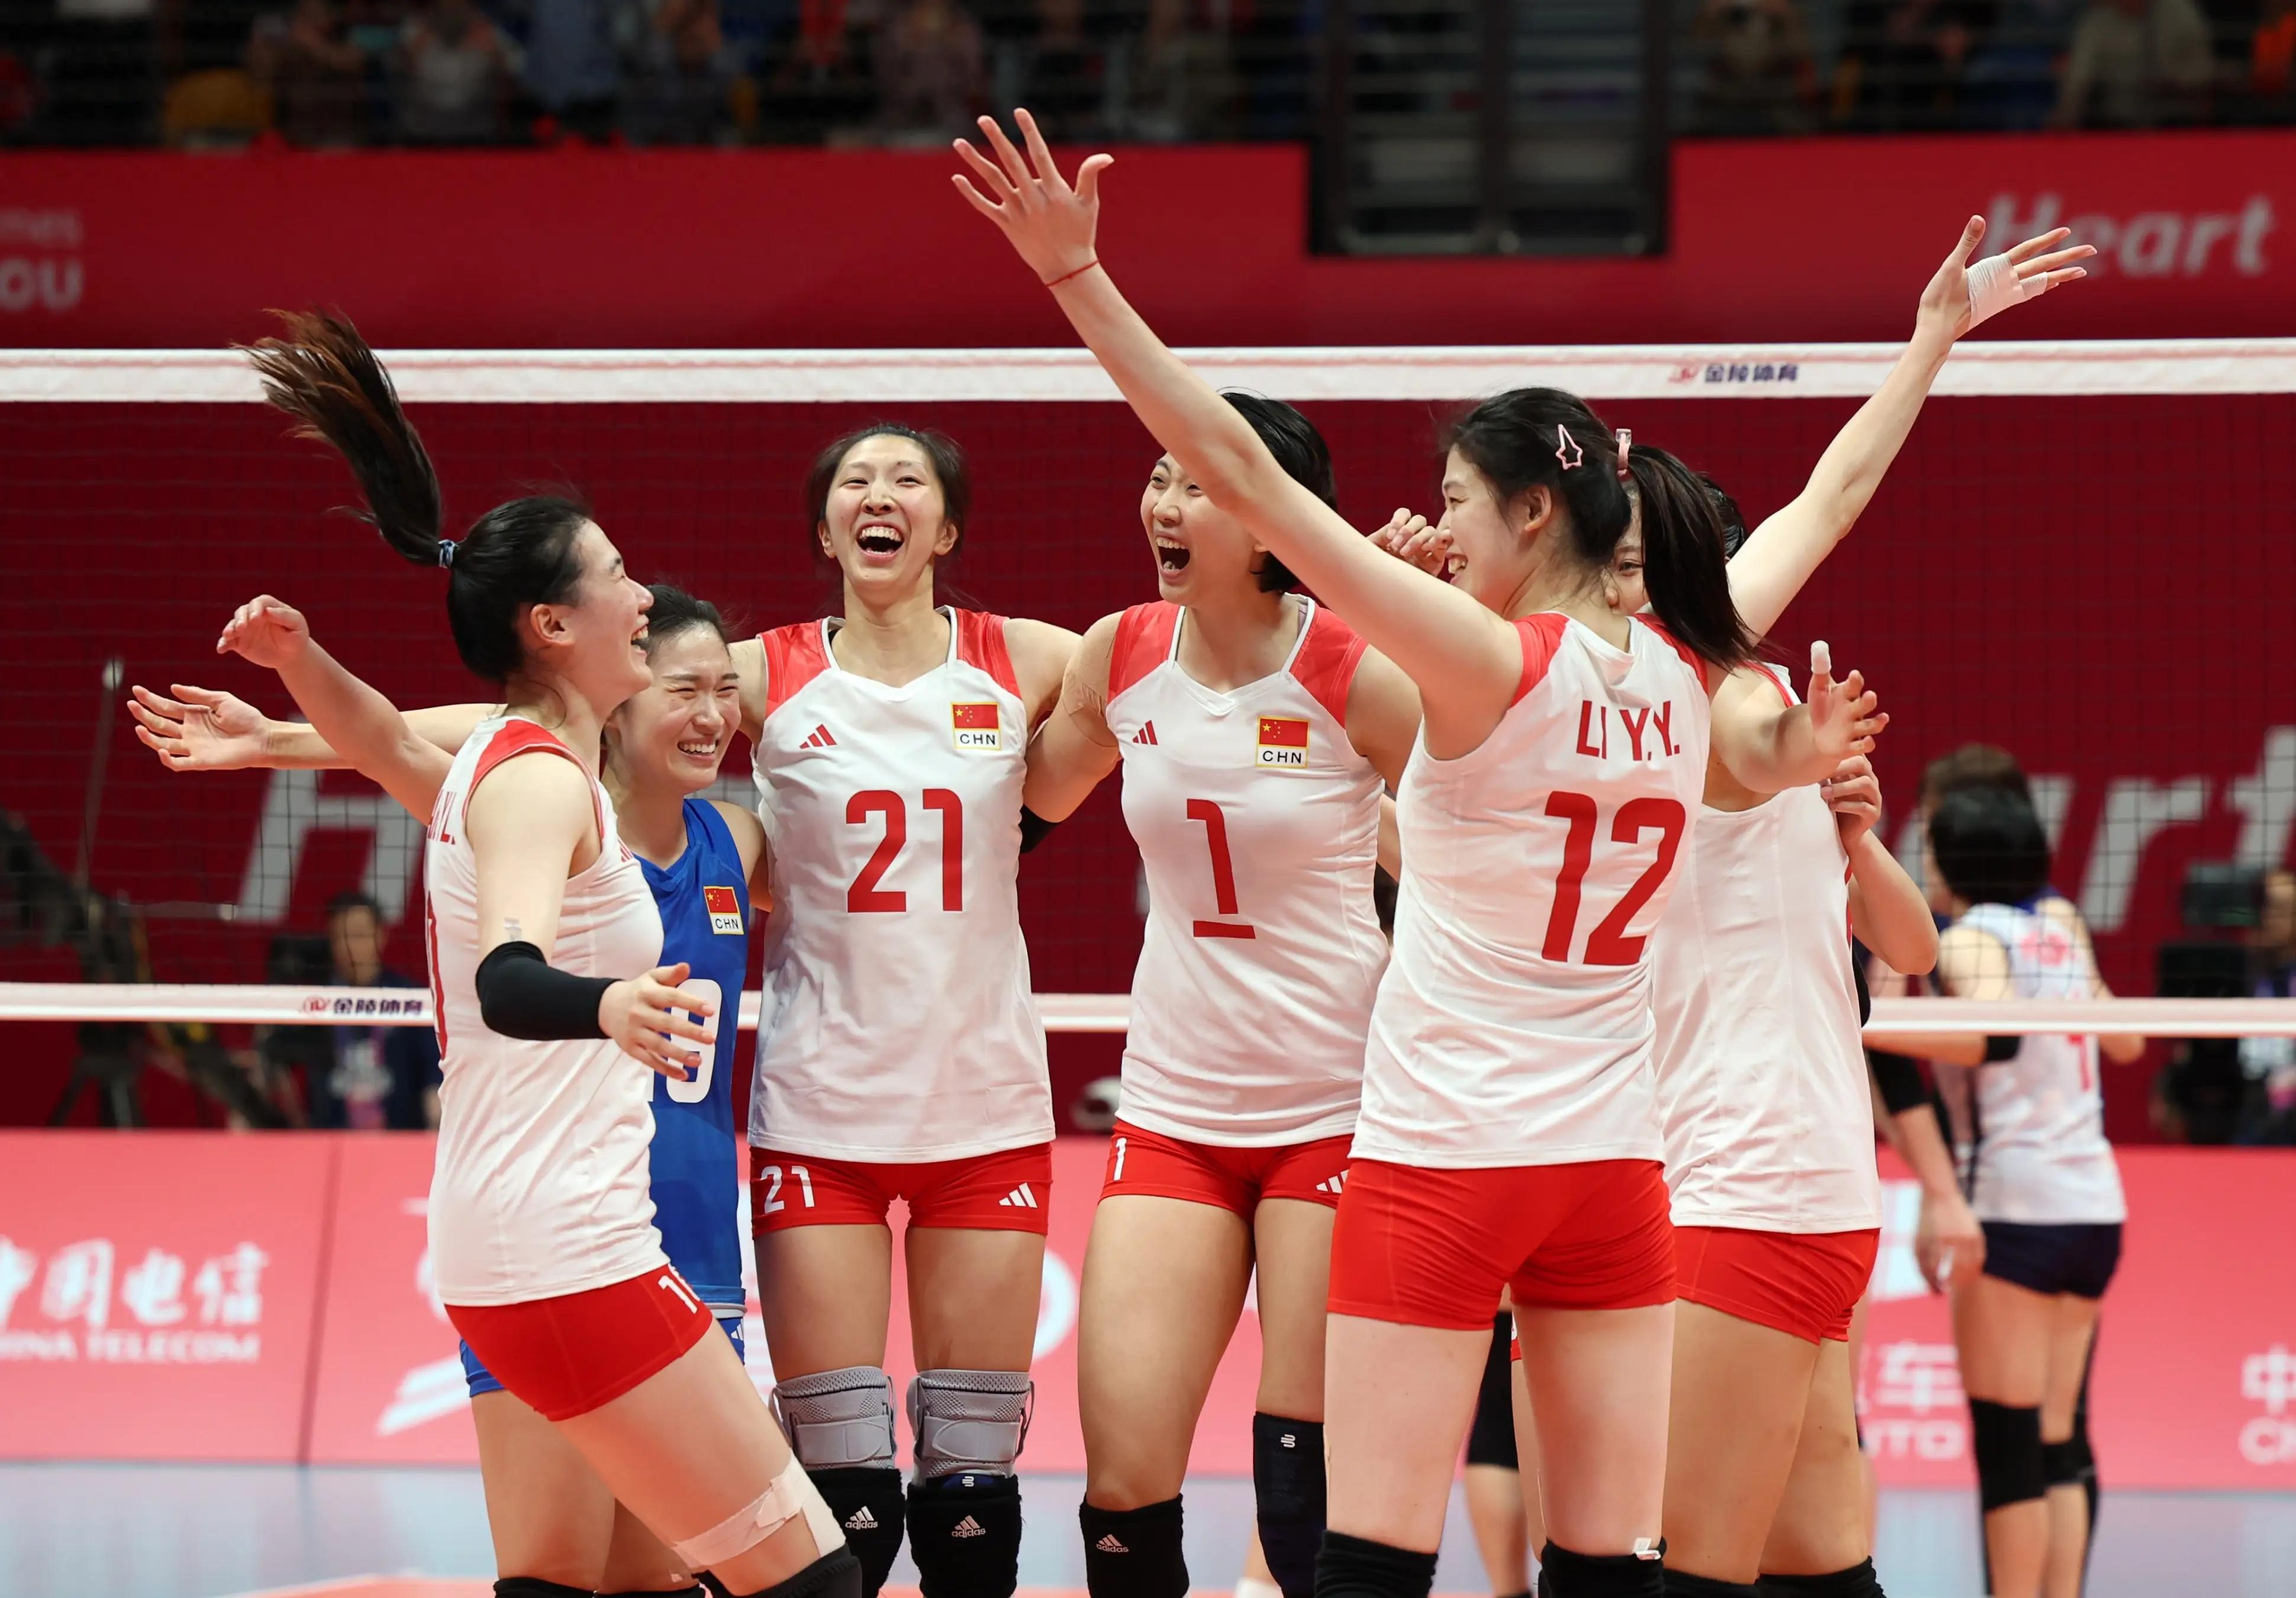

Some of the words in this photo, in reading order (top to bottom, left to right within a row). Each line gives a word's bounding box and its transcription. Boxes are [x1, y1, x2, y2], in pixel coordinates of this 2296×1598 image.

[1981, 194, 2271, 279] Heart
[960, 734, 995, 745] CHN
[1576, 700, 1607, 760] LI
[1262, 751, 1301, 764] CHN
[846, 789, 963, 913] 21
[1187, 799, 1256, 939] 1
[1542, 791, 1686, 966] 12
[715, 918, 739, 930] CHN
[647, 979, 722, 1103] 8
[1114, 1137, 1127, 1181] 1
[760, 1165, 815, 1213] 21
[657, 1263, 701, 1315] 1
[845, 1520, 878, 1530] adidas
[952, 1528, 986, 1538] adidas
[1096, 1544, 1129, 1552] adidas
